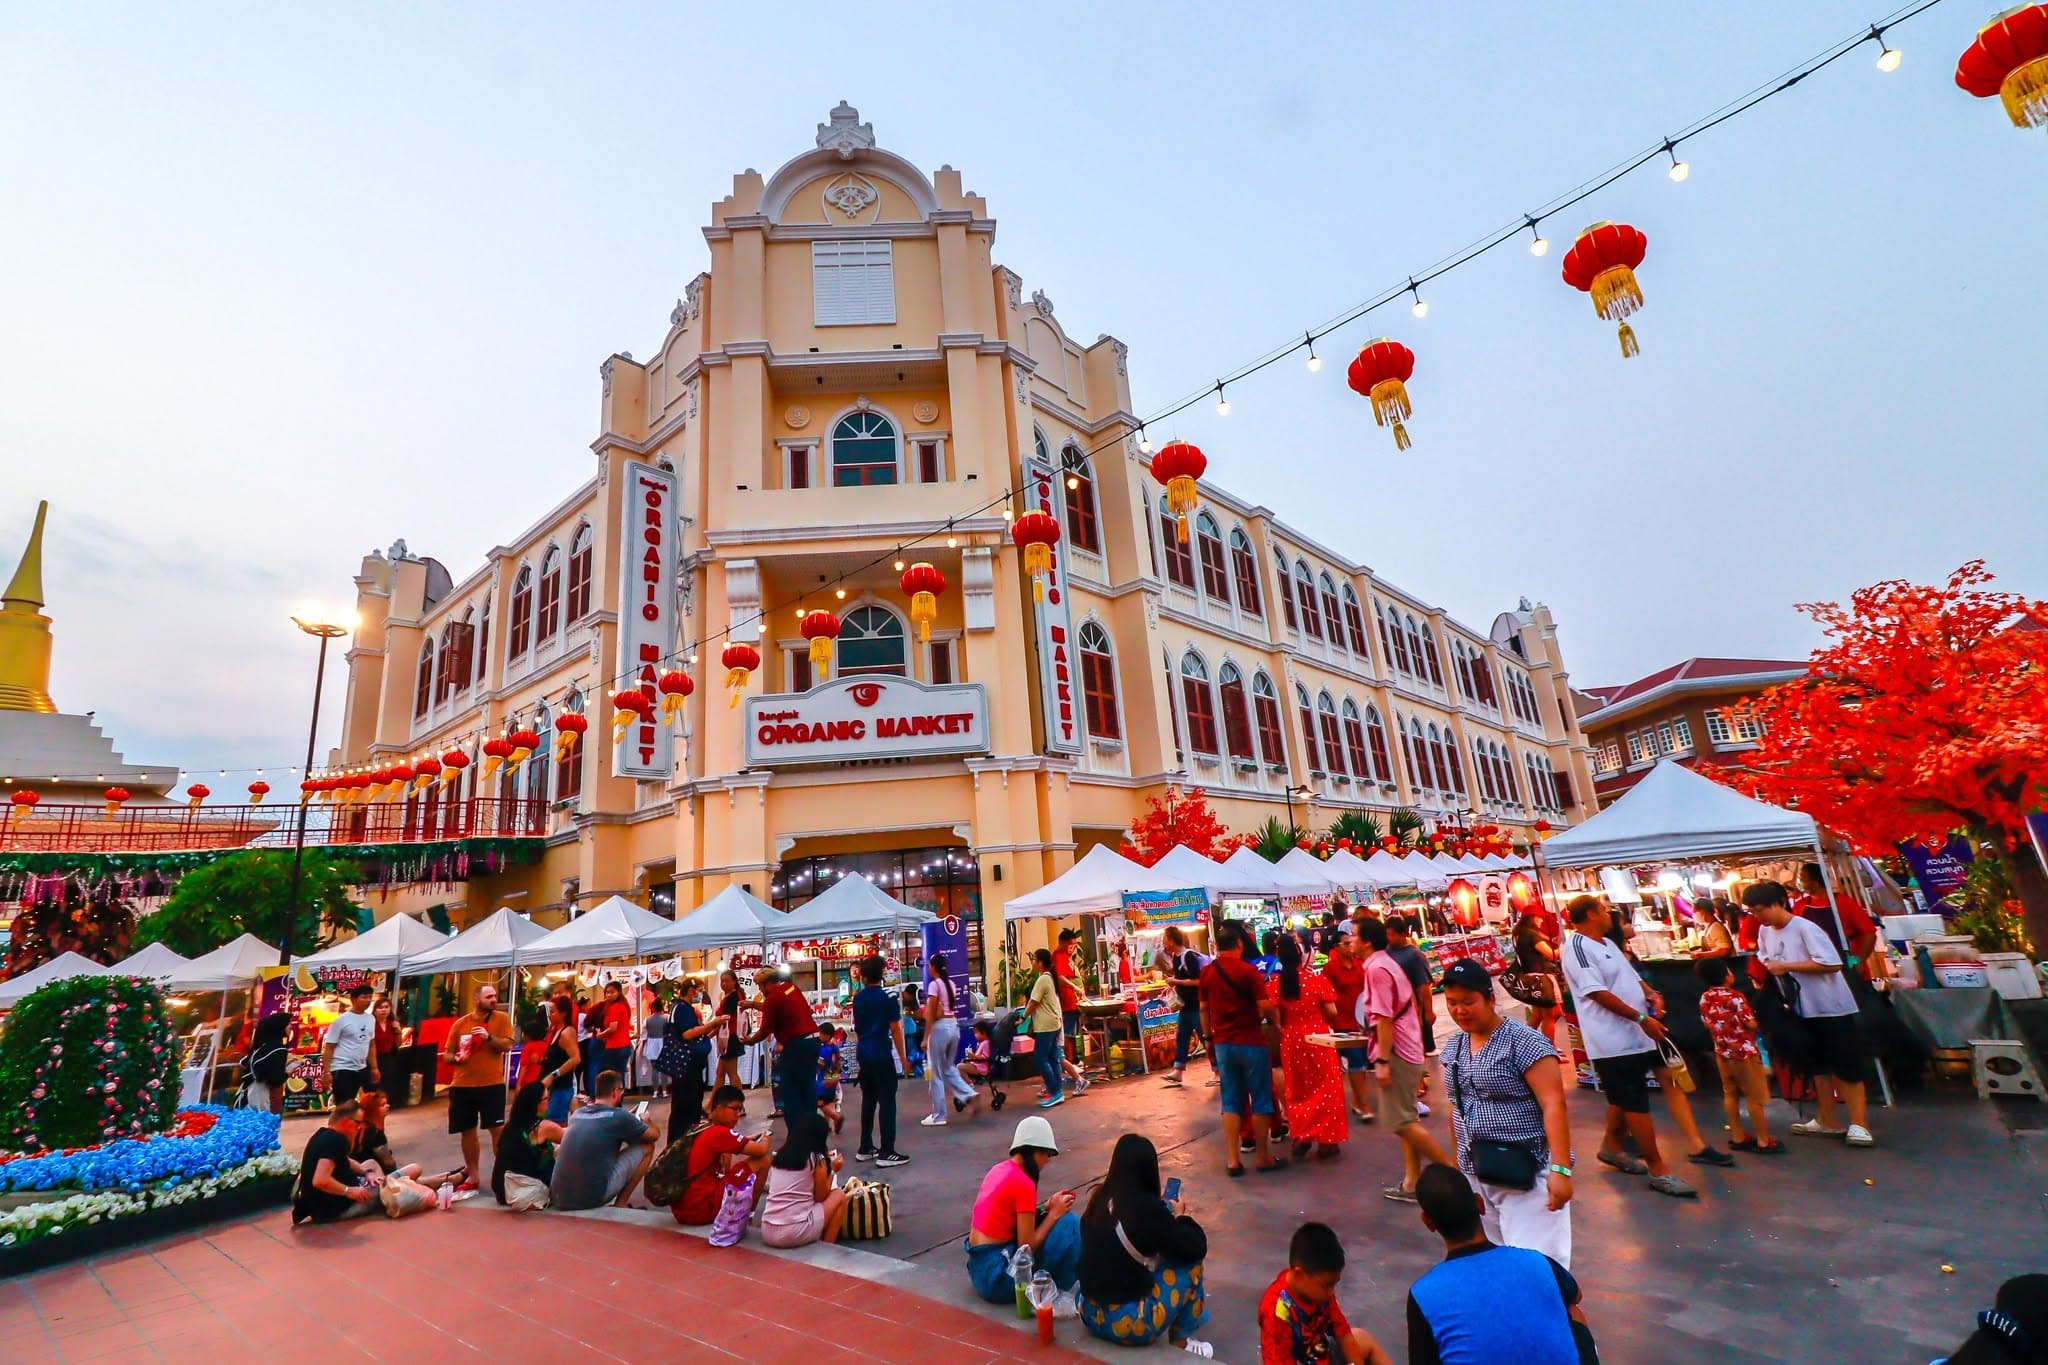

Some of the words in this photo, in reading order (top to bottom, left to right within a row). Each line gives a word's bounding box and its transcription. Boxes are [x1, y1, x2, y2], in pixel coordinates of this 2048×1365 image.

[642, 490, 662, 621] ORGANIC
[638, 643, 660, 766] MARKET
[758, 709, 799, 723] Bangkok
[758, 720, 866, 746] ORGANIC
[876, 713, 974, 738] MARKET
[1051, 625, 1073, 740] MARKET
